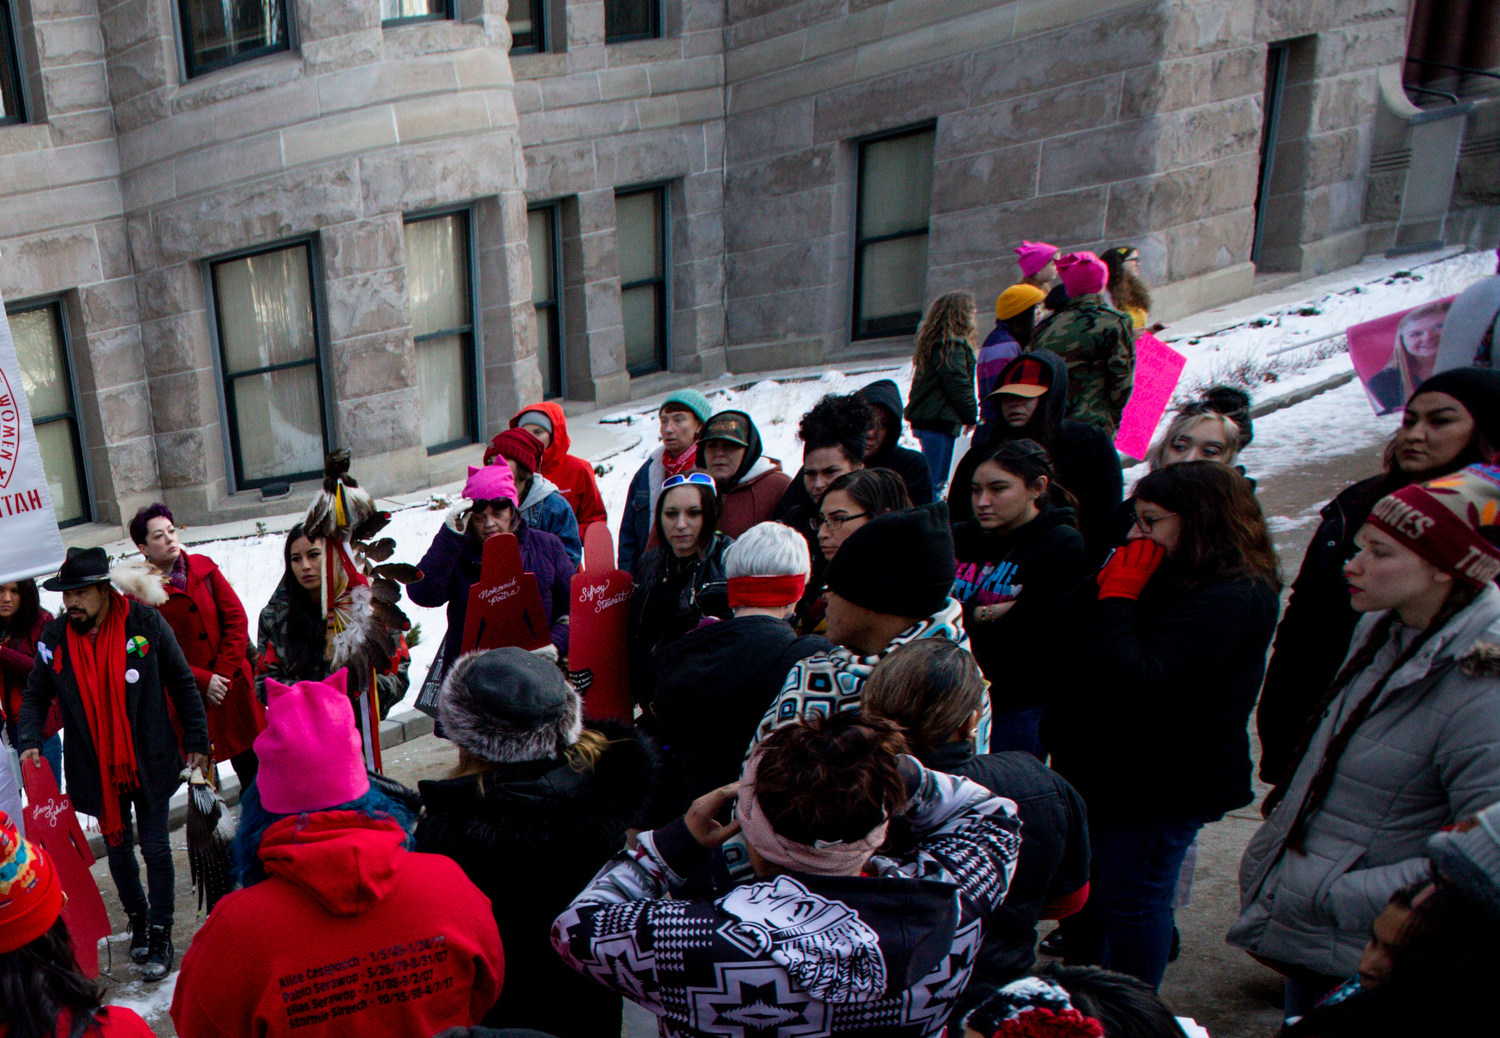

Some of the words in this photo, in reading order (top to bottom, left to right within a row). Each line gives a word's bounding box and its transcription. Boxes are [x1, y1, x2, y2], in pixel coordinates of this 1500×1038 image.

[278, 973, 305, 989] Alice
[282, 984, 312, 1004] Pablo
[289, 1012, 330, 1029] Stormie
